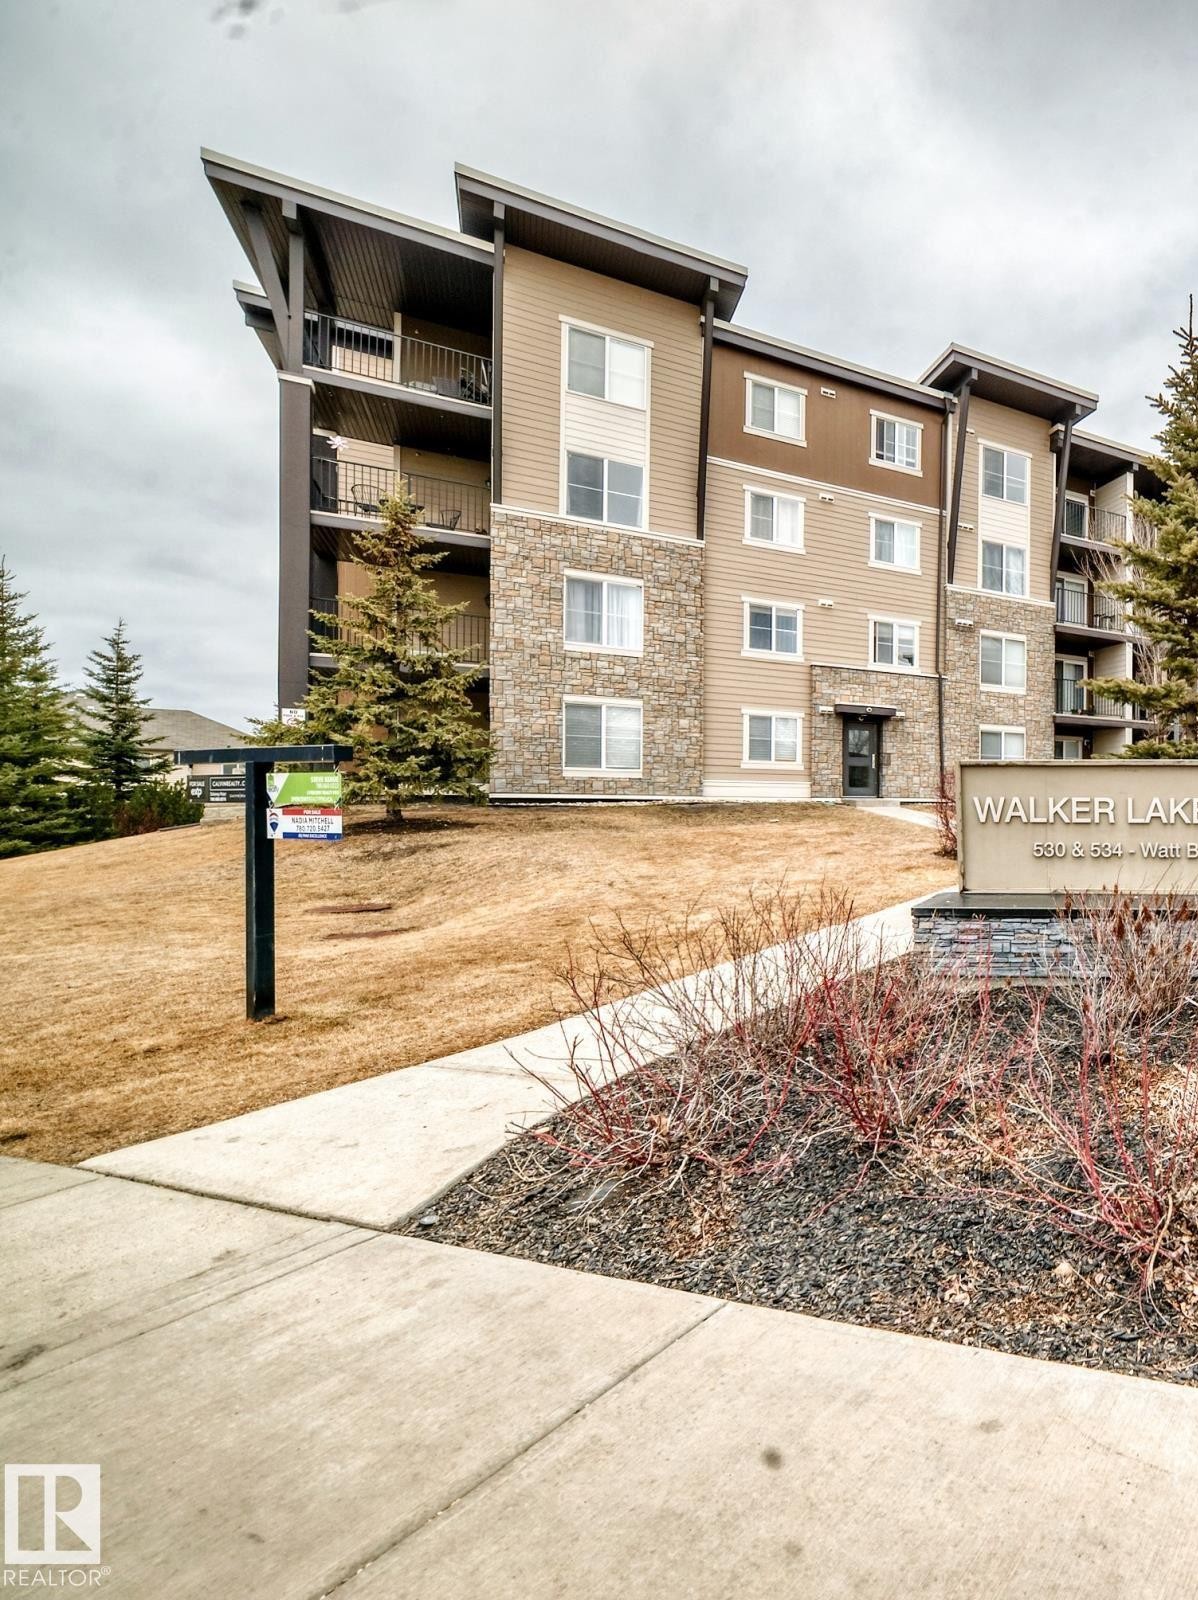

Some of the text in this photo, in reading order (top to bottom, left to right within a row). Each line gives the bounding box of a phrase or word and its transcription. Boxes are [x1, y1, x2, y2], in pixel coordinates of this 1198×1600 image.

[973, 796, 1116, 824] WALKER
[1033, 842, 1066, 858] 530
[1071, 842, 1085, 858] &
[1090, 842, 1122, 858] 534
[1140, 843, 1181, 859] Watt
